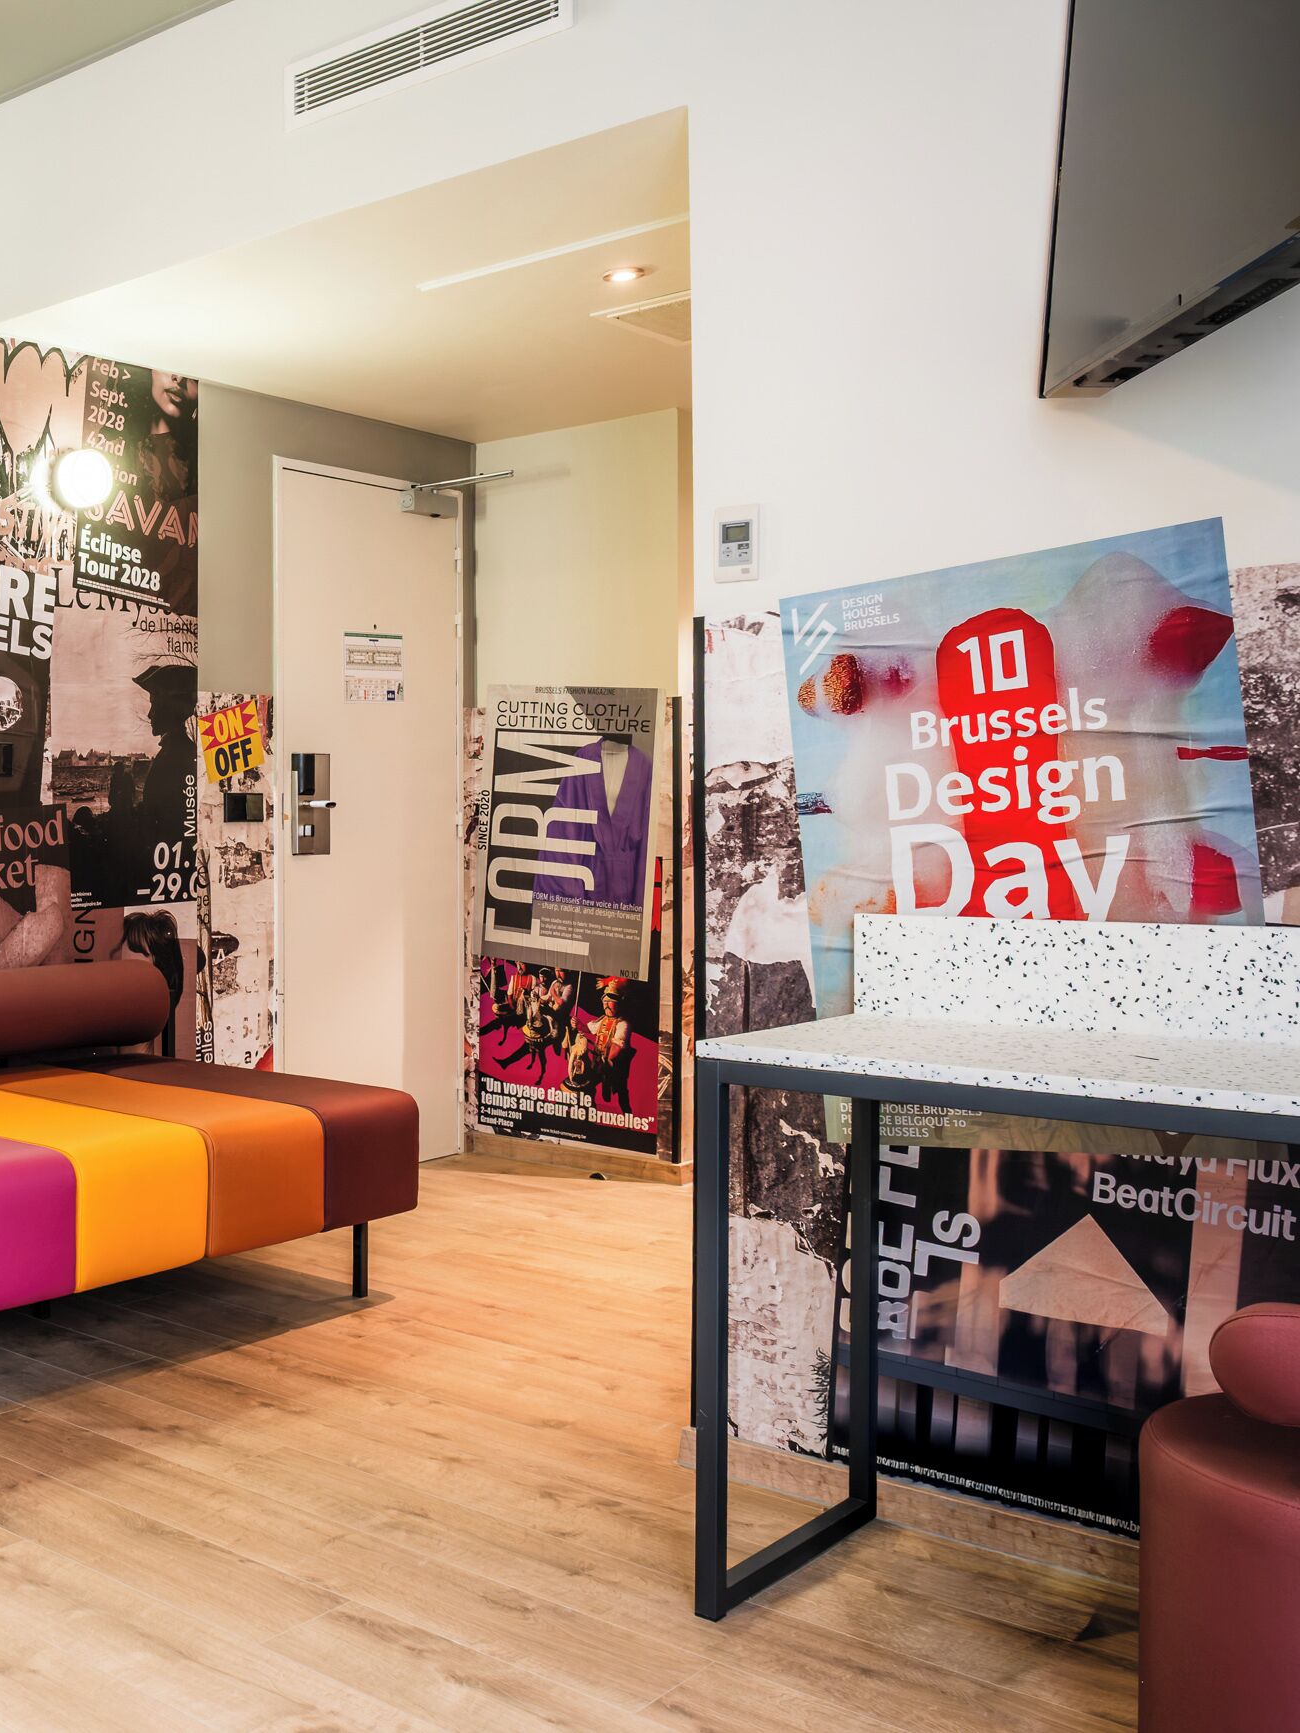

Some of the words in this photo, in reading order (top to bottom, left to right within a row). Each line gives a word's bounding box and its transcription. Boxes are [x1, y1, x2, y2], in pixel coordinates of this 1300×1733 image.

[91, 357, 119, 380] Feb
[89, 381, 129, 408] Sept.
[87, 405, 125, 432] 2028
[85, 430, 126, 457] 42nd
[80, 524, 142, 564] Éclipse
[77, 552, 118, 581] Tour
[120, 564, 161, 592] 2028
[842, 593, 883, 609] DESIGN
[843, 605, 881, 620] HOUSE
[140, 617, 156, 632] de
[844, 613, 900, 632] BRUSSELS
[956, 629, 1029, 694] 10
[535, 687, 562, 695] BRUSSELS
[587, 688, 616, 696] MAGAZINE
[497, 701, 568, 715] CUTTING
[573, 703, 629, 717] CLOTH
[910, 688, 1108, 750] Brussels
[213, 707, 245, 743] ON
[496, 715, 567, 729] CUTTING
[572, 717, 651, 733] CULTURE
[215, 737, 252, 777] OFF
[885, 745, 1126, 824] Design
[480, 789, 490, 816] 2020
[478, 817, 487, 851] SINCE
[890, 823, 1130, 921] Day
[533, 892, 548, 900] FORM
[582, 899, 595, 908] new
[596, 901, 612, 909] voice
[620, 902, 643, 912] fashion
[481, 1091, 517, 1110] temps
[519, 1098, 534, 1111] au
[536, 1102, 568, 1117] cœur
[570, 1105, 586, 1120] de
[503, 1082, 545, 1101] voyage
[547, 1087, 577, 1105] dans
[579, 1092, 592, 1108] le
[480, 1116, 514, 1128] Grand-Place
[491, 1107, 508, 1117] juillet
[508, 1110, 522, 1120] 2001
[894, 1116, 950, 1127] BELGIQUE
[953, 1120, 967, 1128] 10
[1092, 1171, 1297, 1241] BeatCircuit
